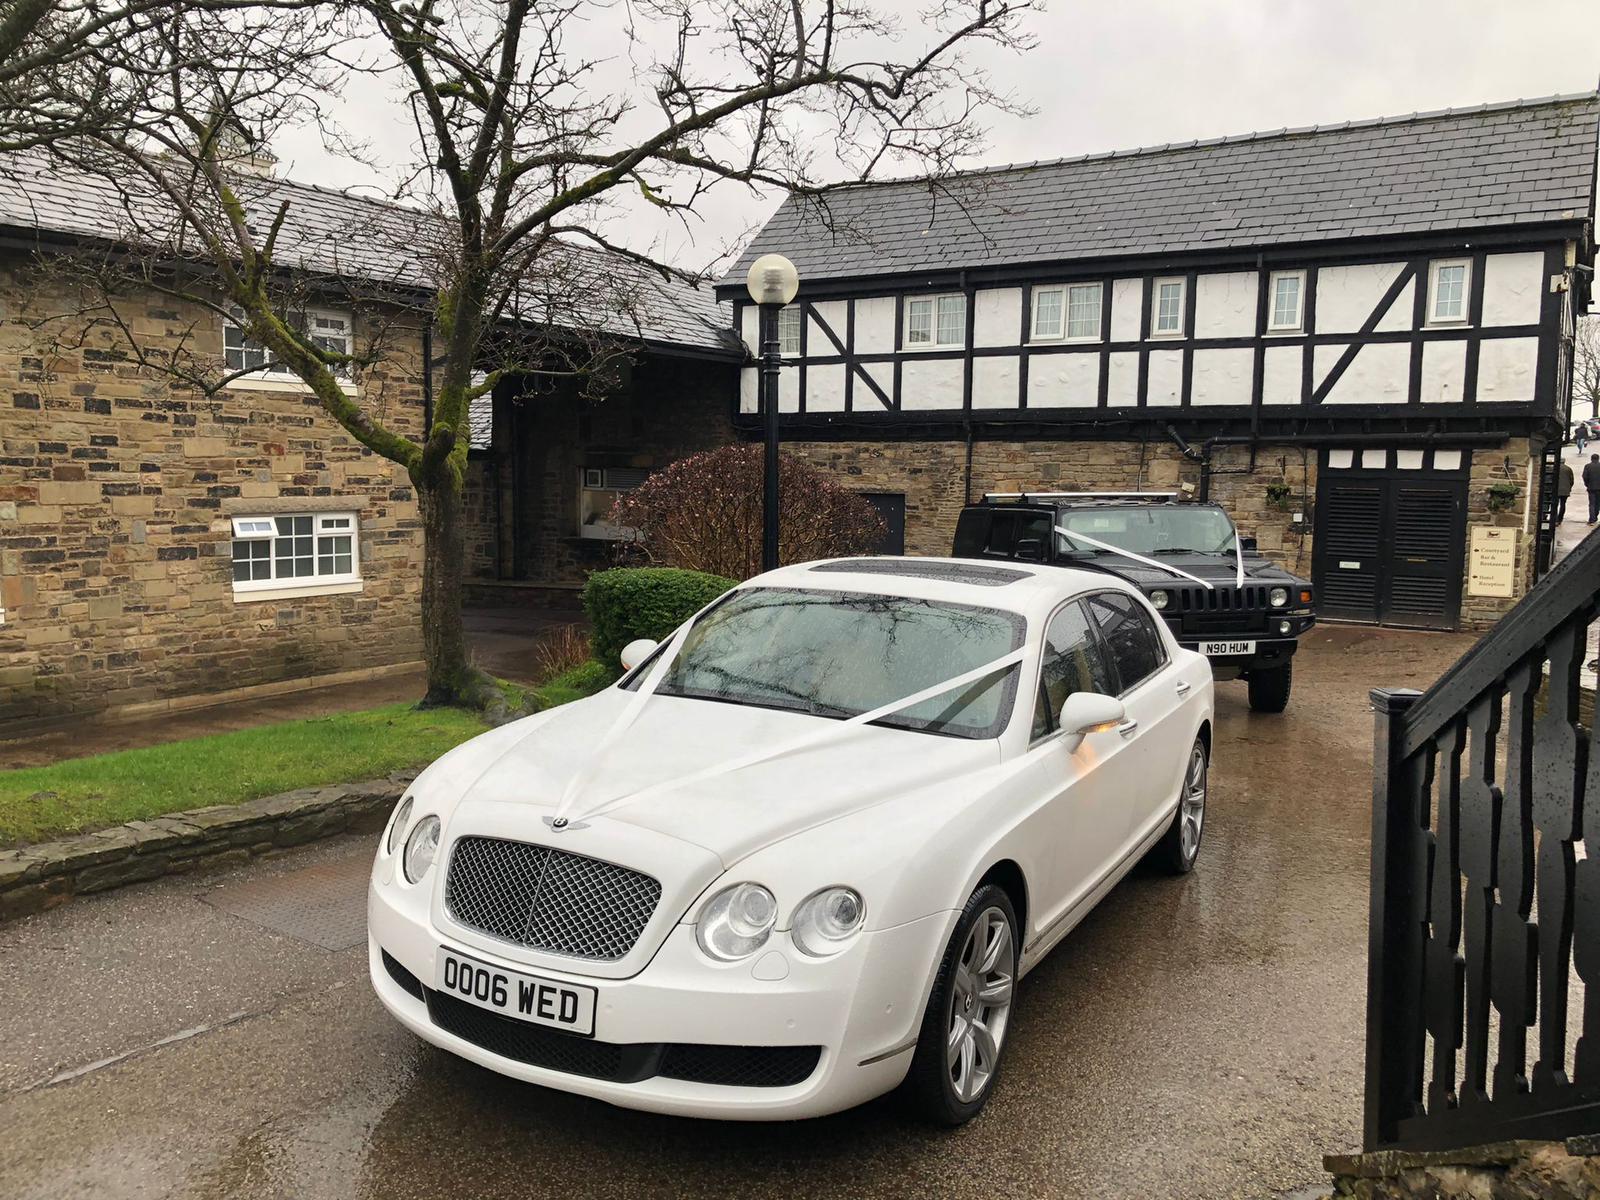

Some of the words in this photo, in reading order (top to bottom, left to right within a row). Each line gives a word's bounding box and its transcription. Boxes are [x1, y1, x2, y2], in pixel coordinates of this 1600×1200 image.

[1206, 643, 1227, 654] N90
[1229, 642, 1249, 653] HUM
[518, 980, 579, 1024] WED
